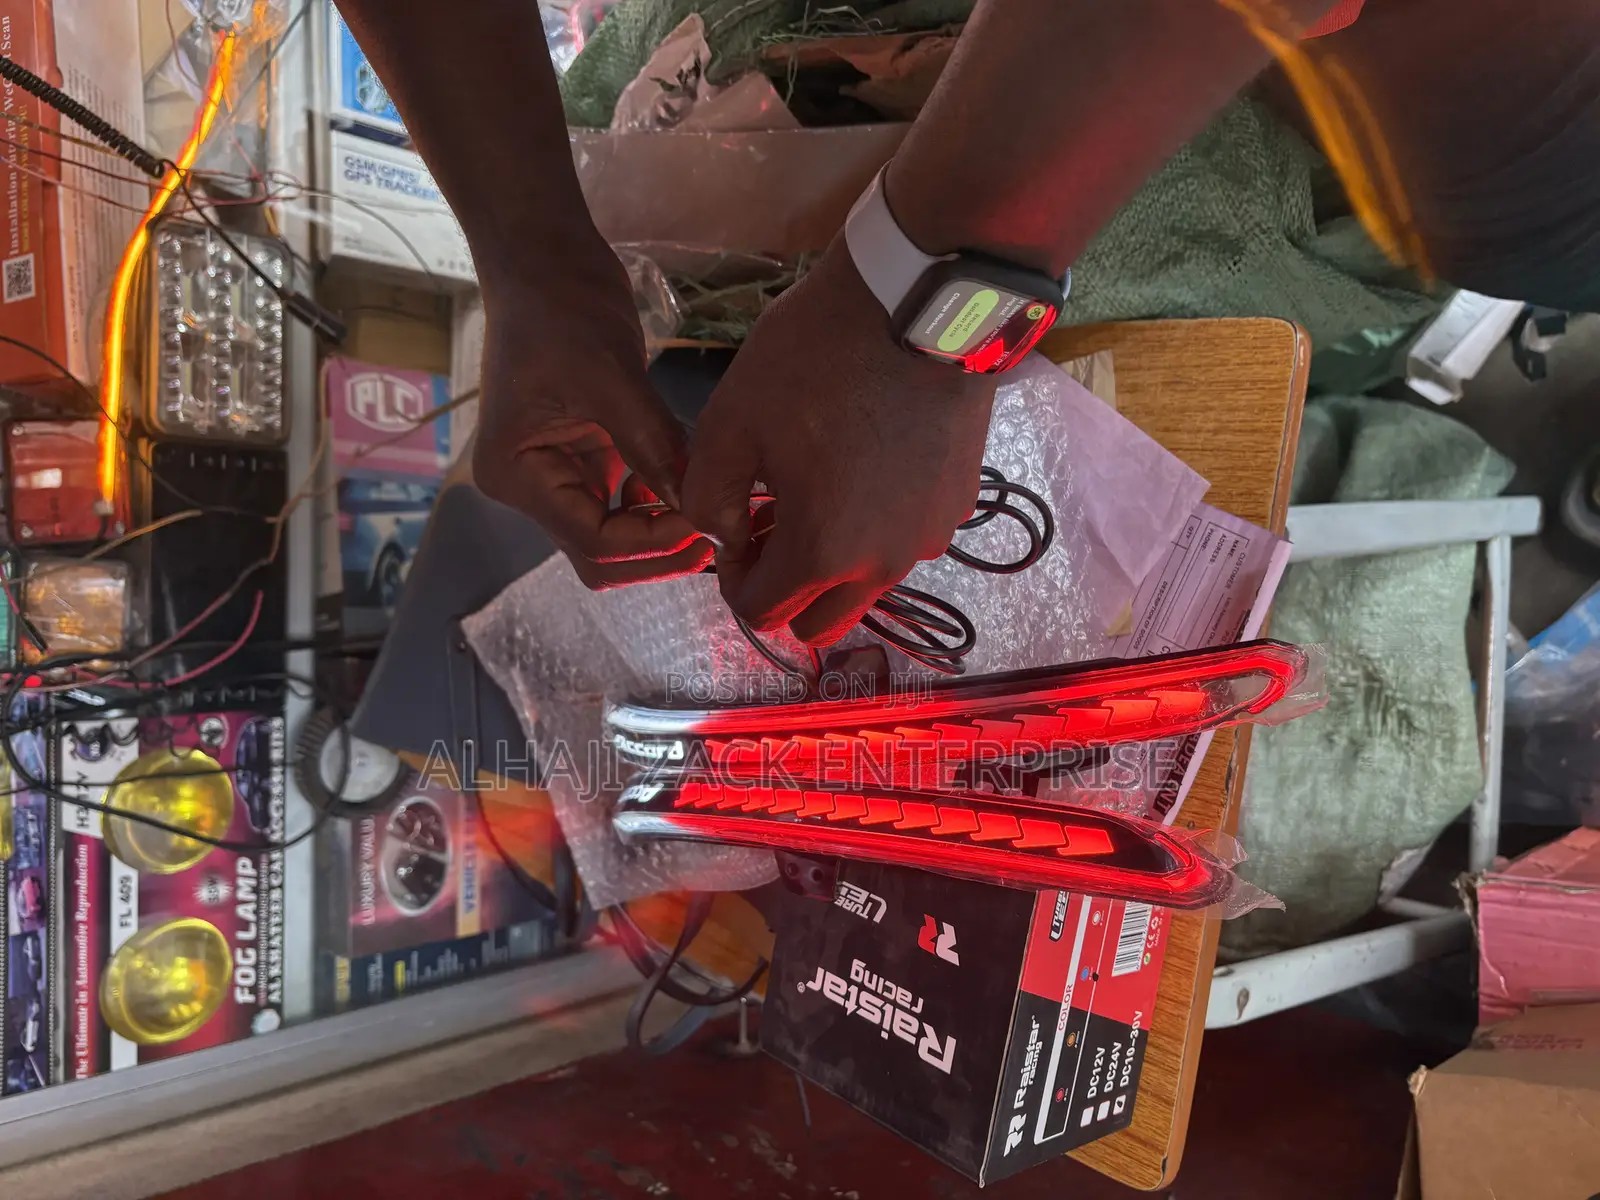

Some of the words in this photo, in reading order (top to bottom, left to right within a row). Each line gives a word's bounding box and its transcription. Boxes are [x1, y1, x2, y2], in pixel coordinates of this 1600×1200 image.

[1, 16, 12, 49] Scan
[2, 54, 13, 110] WeCt
[8, 171, 20, 255] Installation
[925, 311, 944, 334] Workout
[942, 292, 960, 312] Change
[963, 314, 980, 332] Record
[1185, 526, 1194, 539] QTY
[1209, 534, 1227, 565] ADDRESS:
[1228, 539, 1240, 559] NAME:
[1225, 552, 1246, 589] CUSTOMER
[1149, 580, 1168, 620] DESCRIPTION
[1133, 628, 1146, 649] GOODS
[74, 843, 90, 921] Reproduction
[118, 874, 132, 904] 409
[236, 856, 258, 941] LAMP
[360, 861, 375, 925] LUXURY
[118, 908, 132, 928] FL
[75, 924, 88, 988] Automotive
[234, 948, 257, 1004] FOG
[850, 958, 924, 1014] racing
[1057, 983, 1074, 1031] COLOR
[75, 1006, 88, 1056] Ultimate
[805, 967, 957, 1075] Raistar
[76, 1059, 88, 1079] The
[1014, 1020, 1041, 1109] Raistar
[1028, 1040, 1043, 1085] racing
[1087, 1046, 1106, 1099] DC12V
[1103, 1041, 1122, 1093] DC24V
[1119, 1010, 1143, 1088] DC10-30V
